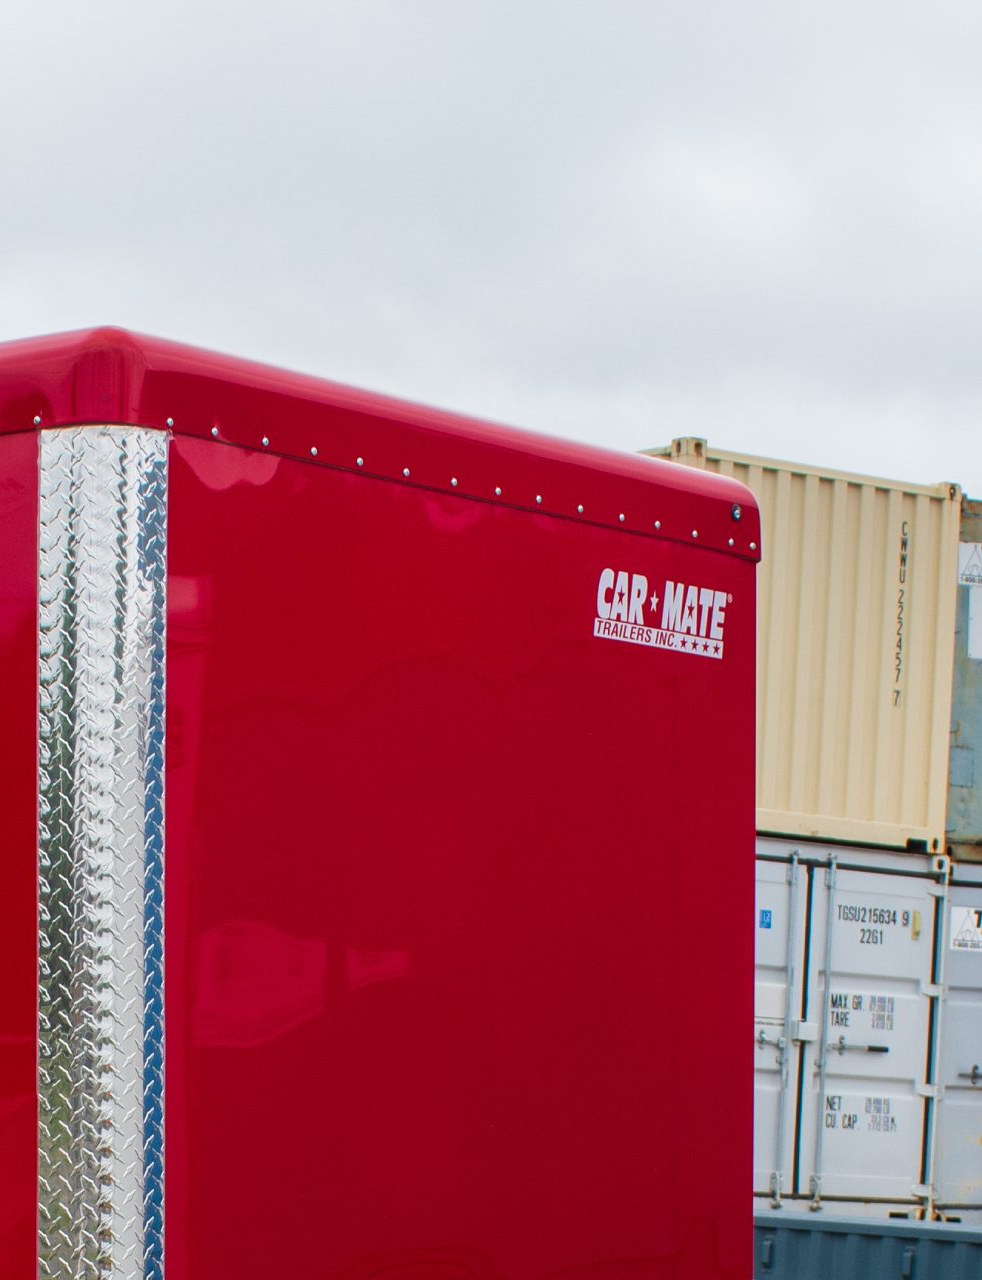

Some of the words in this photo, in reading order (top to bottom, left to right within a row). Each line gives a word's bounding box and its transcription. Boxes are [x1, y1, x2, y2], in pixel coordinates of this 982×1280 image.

[596, 568, 649, 625] CAR
[660, 580, 727, 641] MATE
[596, 620, 652, 643] TRAILERS
[655, 632, 678, 648] INC.
[837, 904, 897, 925] TGSU215634
[902, 910, 910, 928] 9
[830, 1011, 850, 1027] TARE
[825, 1095, 842, 1111] NET
